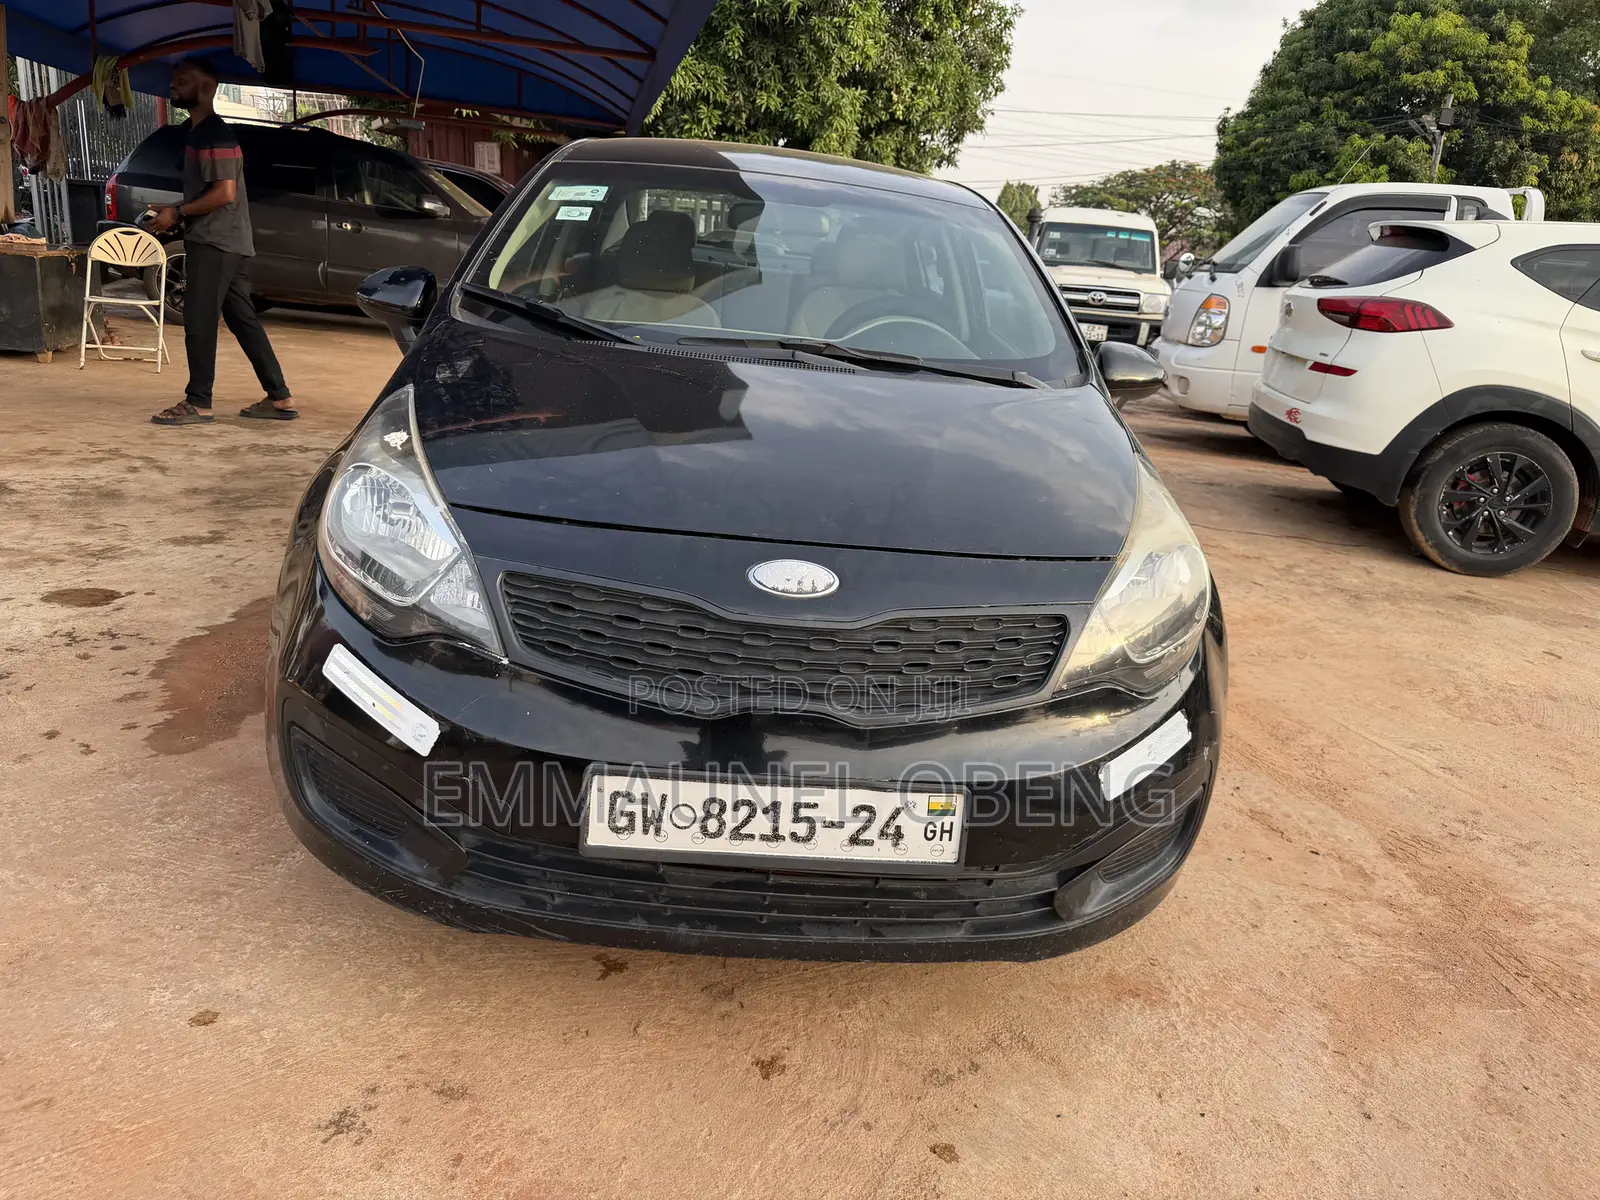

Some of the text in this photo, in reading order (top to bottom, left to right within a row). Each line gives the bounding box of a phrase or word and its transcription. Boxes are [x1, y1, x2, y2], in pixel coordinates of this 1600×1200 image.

[608, 789, 905, 847] GW 8215-24
[923, 820, 955, 842] GH
